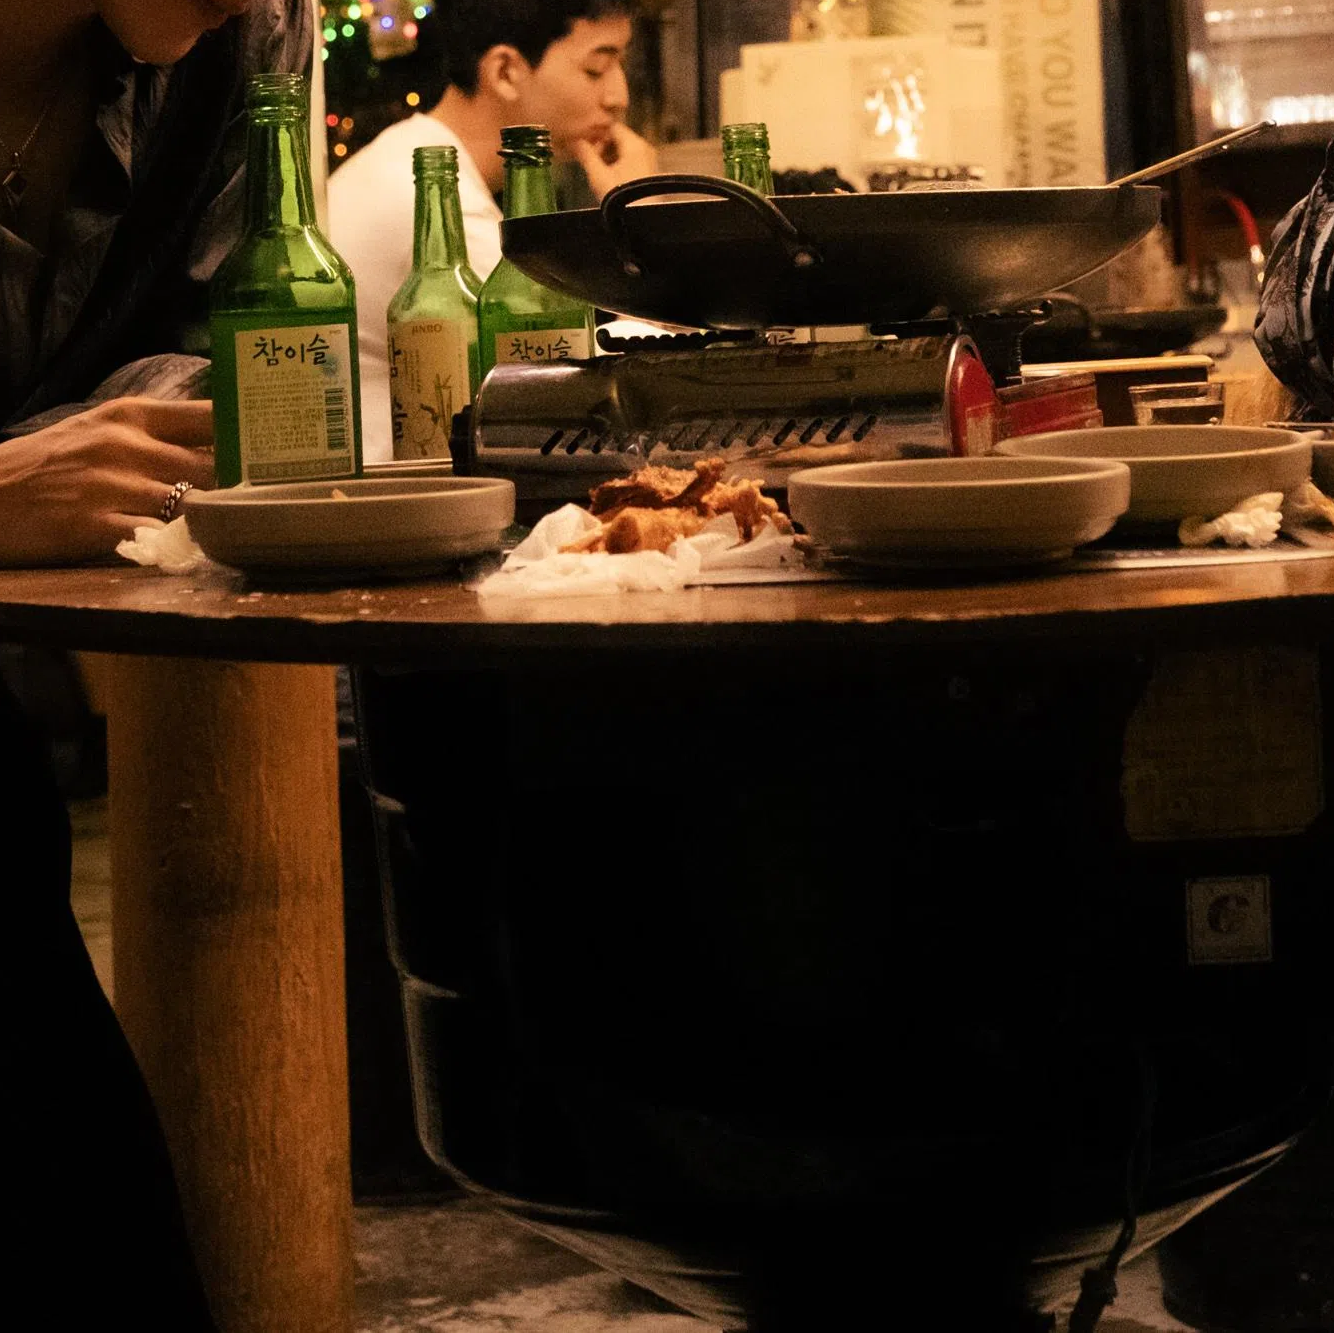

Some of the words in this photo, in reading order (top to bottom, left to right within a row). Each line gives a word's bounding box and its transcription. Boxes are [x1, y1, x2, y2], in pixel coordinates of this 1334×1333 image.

[1040, 30, 1075, 108] YOU
[1044, 119, 1078, 184] WA
[252, 333, 330, 367] 참이슬
[509, 335, 572, 362] 참이슬
